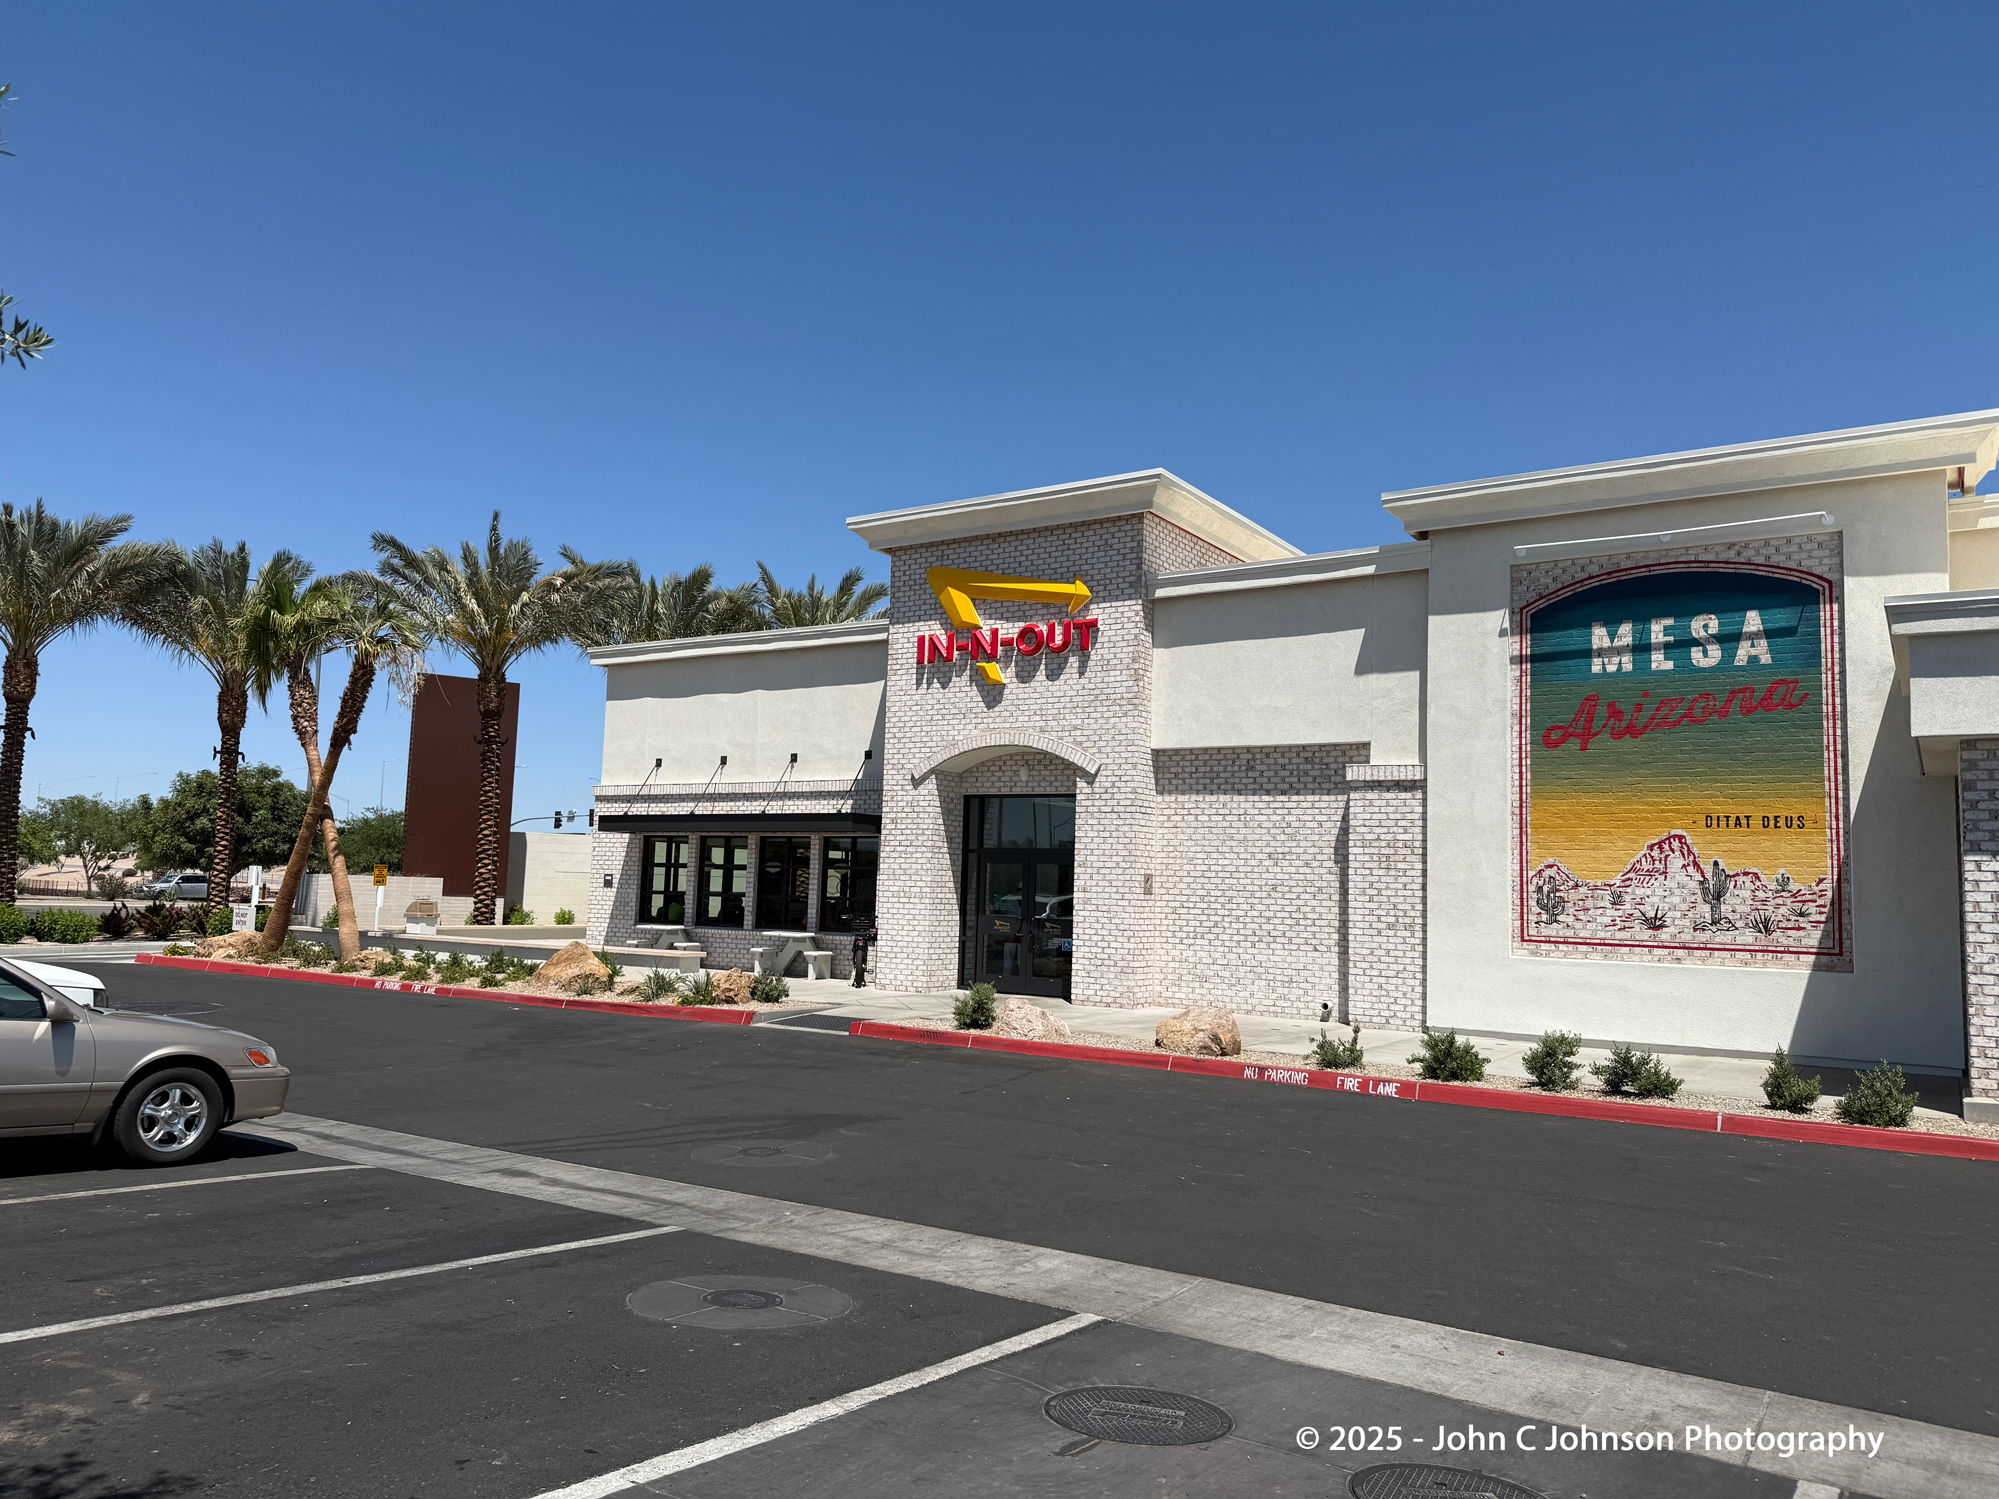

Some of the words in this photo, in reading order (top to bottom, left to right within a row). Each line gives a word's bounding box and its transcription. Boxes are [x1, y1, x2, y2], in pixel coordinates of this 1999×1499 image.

[916, 618, 1099, 665] IN-N-OUT
[1591, 609, 1773, 674] MESA
[1541, 678, 1811, 752] Arizona
[1705, 814, 1752, 829] DITAT
[1761, 815, 1806, 829] DEUS
[374, 980, 383, 989] NO
[383, 981, 402, 991] PARKING
[411, 984, 423, 993] FIRE
[423, 985, 437, 995] LANE
[1244, 1065, 1258, 1079] NO
[1264, 1067, 1309, 1085] PARKING
[1336, 1076, 1363, 1092] FIRE
[1368, 1079, 1401, 1097] LANE
